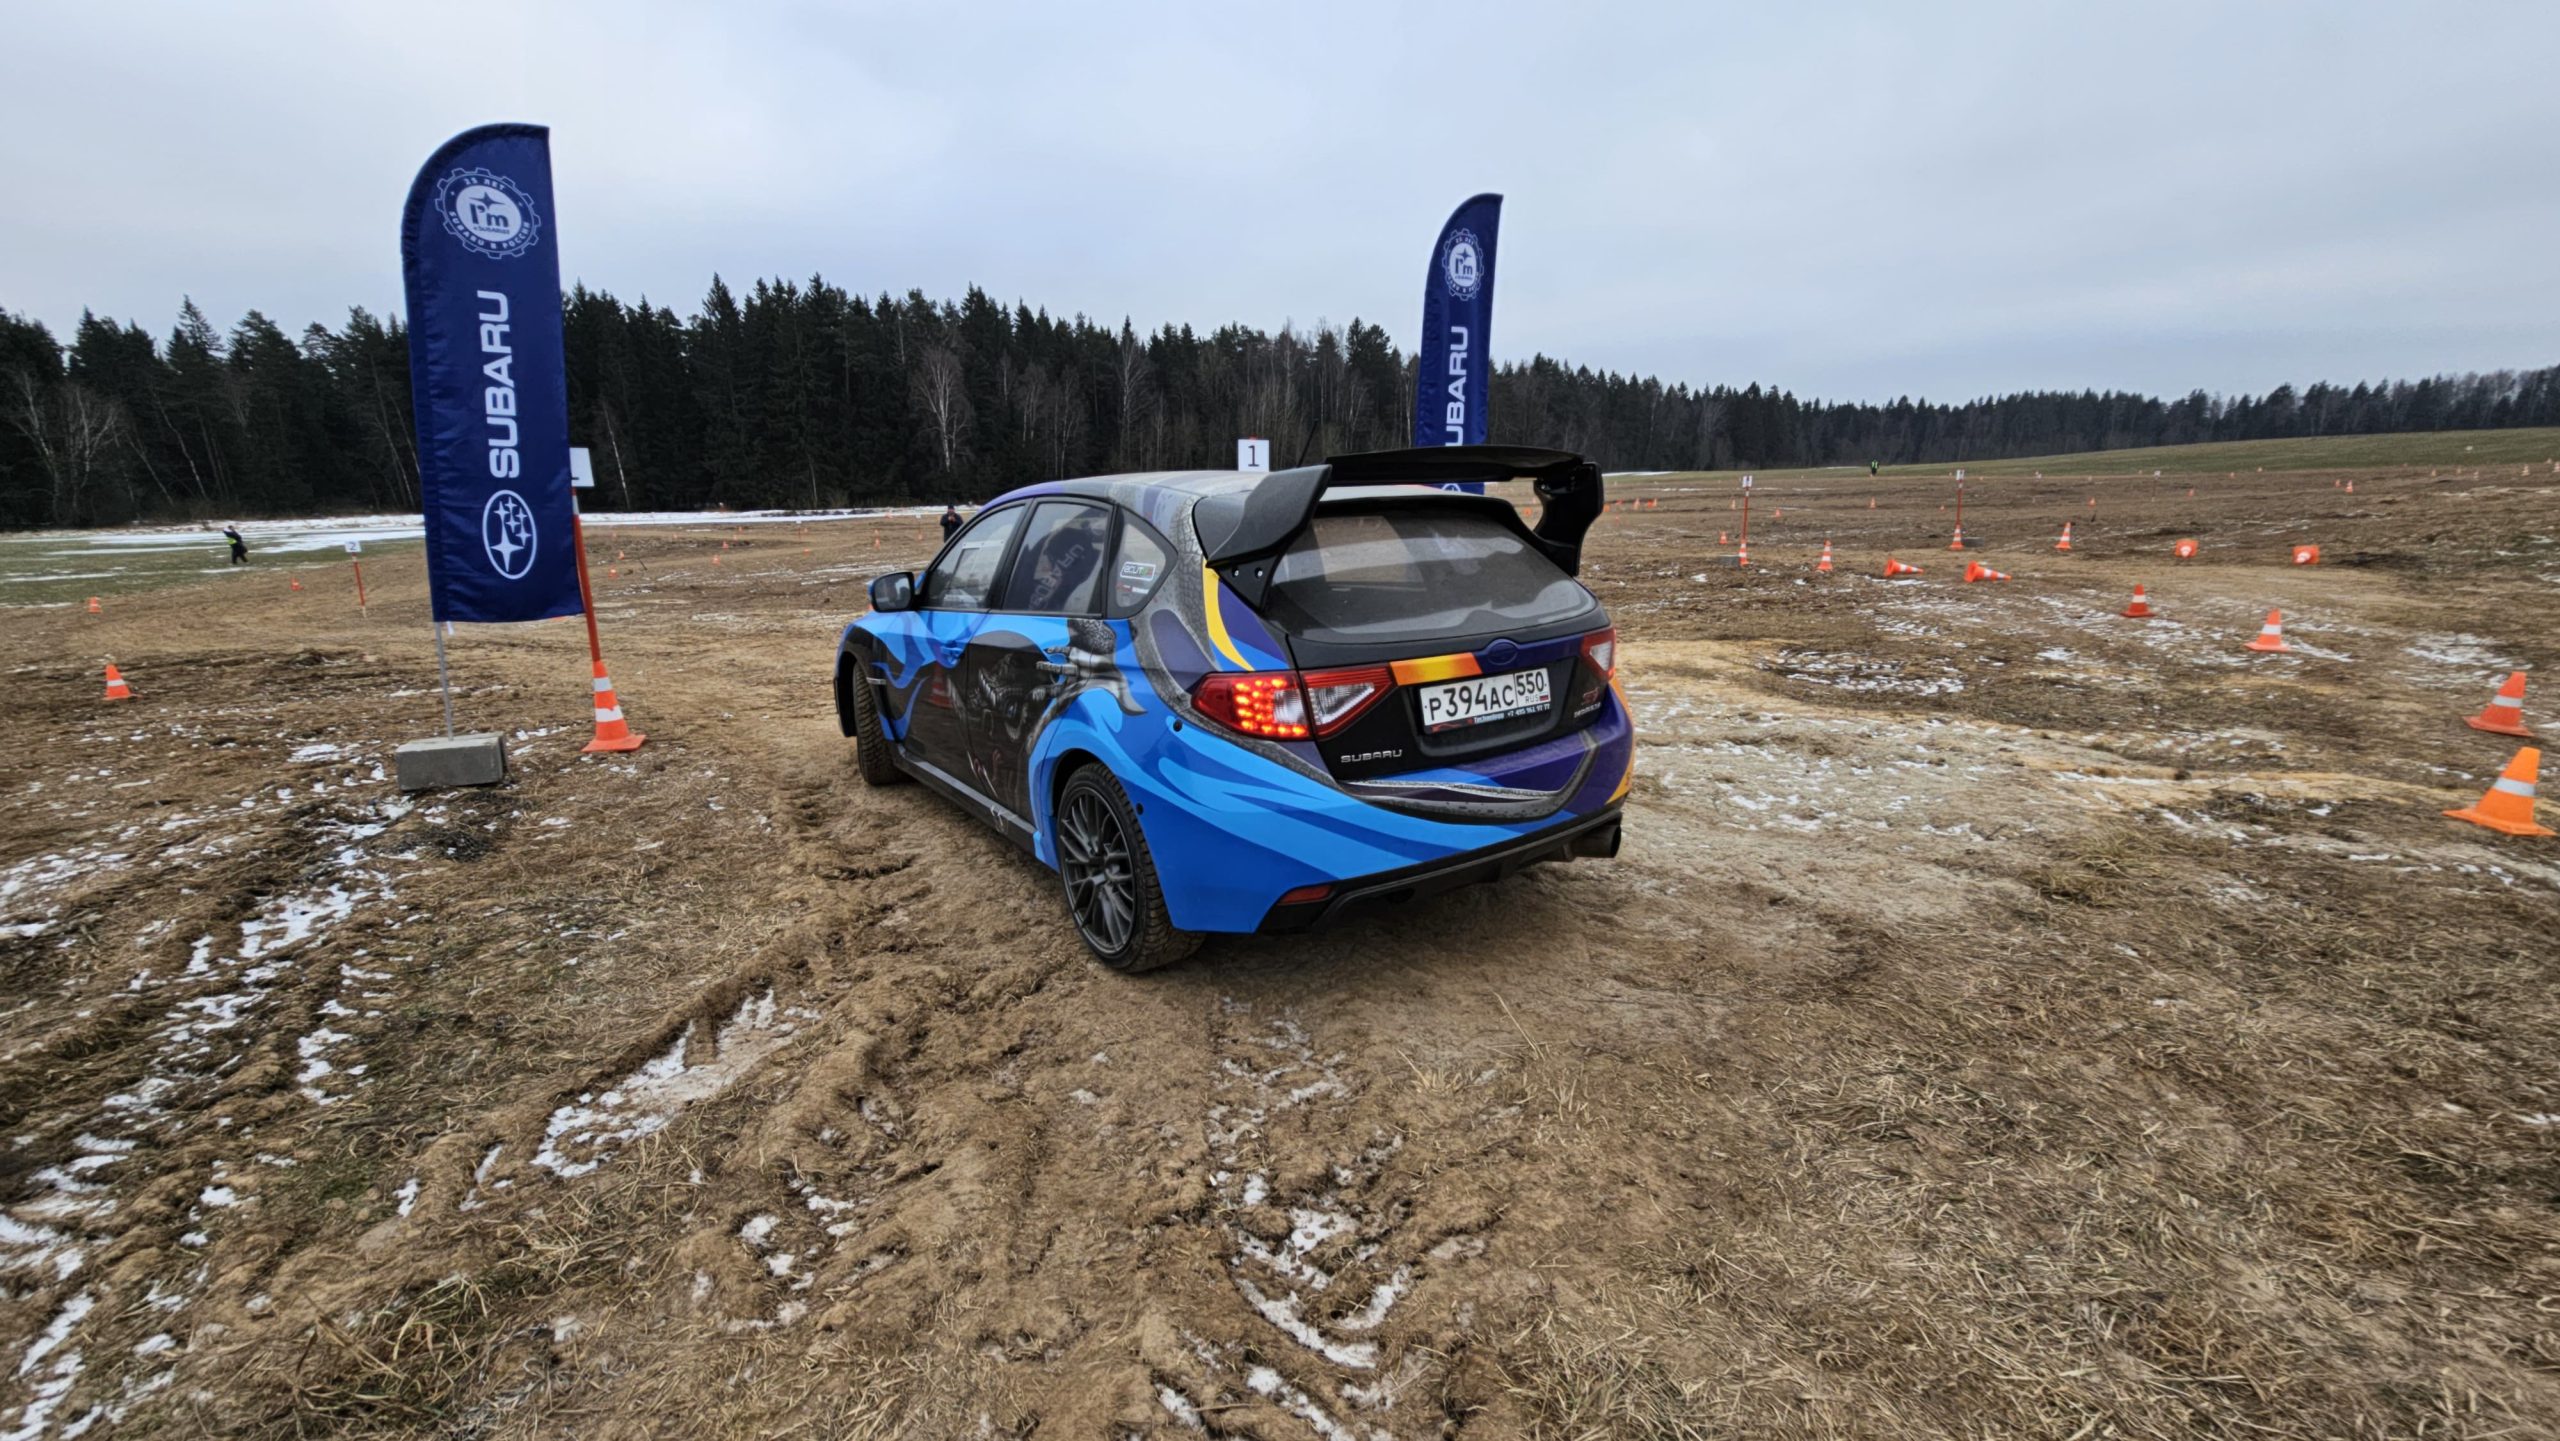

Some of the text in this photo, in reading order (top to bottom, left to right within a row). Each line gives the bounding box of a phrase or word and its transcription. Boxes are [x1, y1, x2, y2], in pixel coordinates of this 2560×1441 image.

[448, 210, 485, 246] SUBARU
[477, 290, 520, 478] SUBARU
[1445, 326, 1469, 446] UBARU
[1248, 445, 1260, 467] 1
[349, 541, 357, 551] 2
[1515, 671, 1544, 696] 550
[1525, 694, 1539, 703] RUS
[1341, 749, 1402, 763] SUBARU
